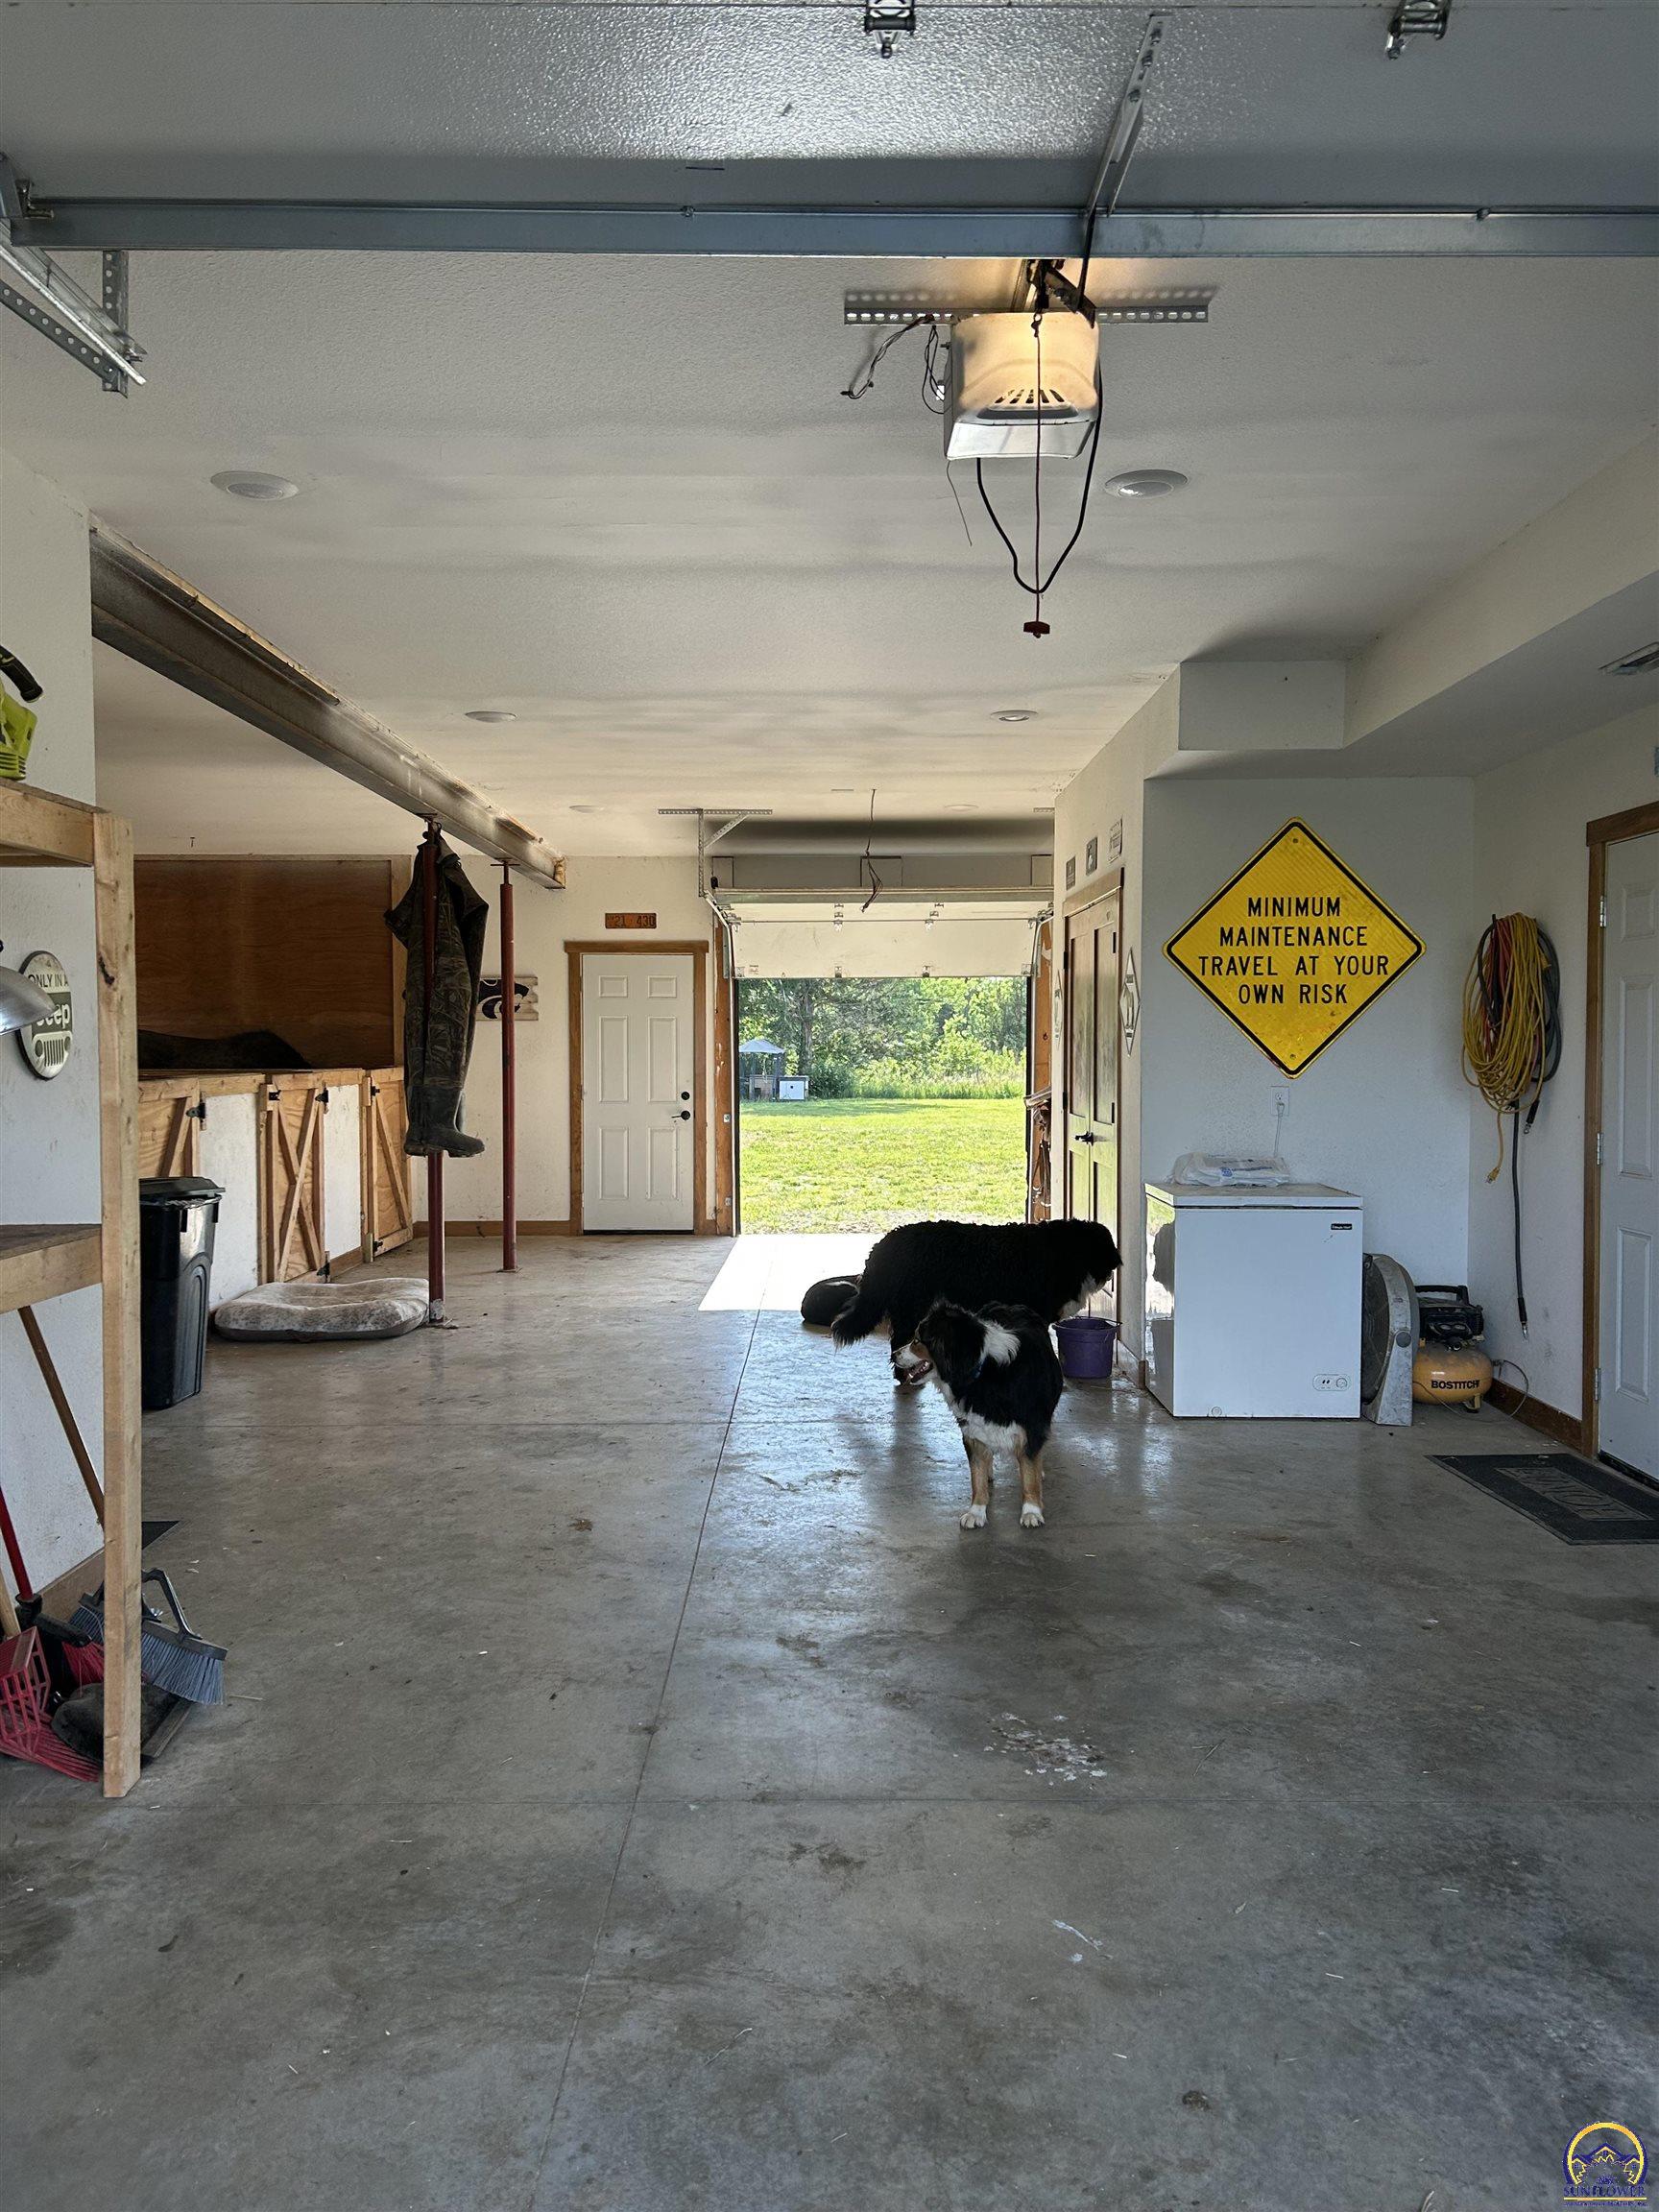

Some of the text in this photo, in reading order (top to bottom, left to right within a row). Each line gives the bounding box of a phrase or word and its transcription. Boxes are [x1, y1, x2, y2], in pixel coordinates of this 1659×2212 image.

[1248, 897, 1341, 917] MINIMUM
[1219, 926, 1368, 947] MAINTENANCE
[1198, 955, 1389, 976] TRAVEL AT YOUR
[28, 974, 53, 987] ONLY
[55, 974, 62, 987] IN
[1238, 984, 1348, 1004] OWN RISK
[1431, 1379, 1480, 1389] BOSTITCH
